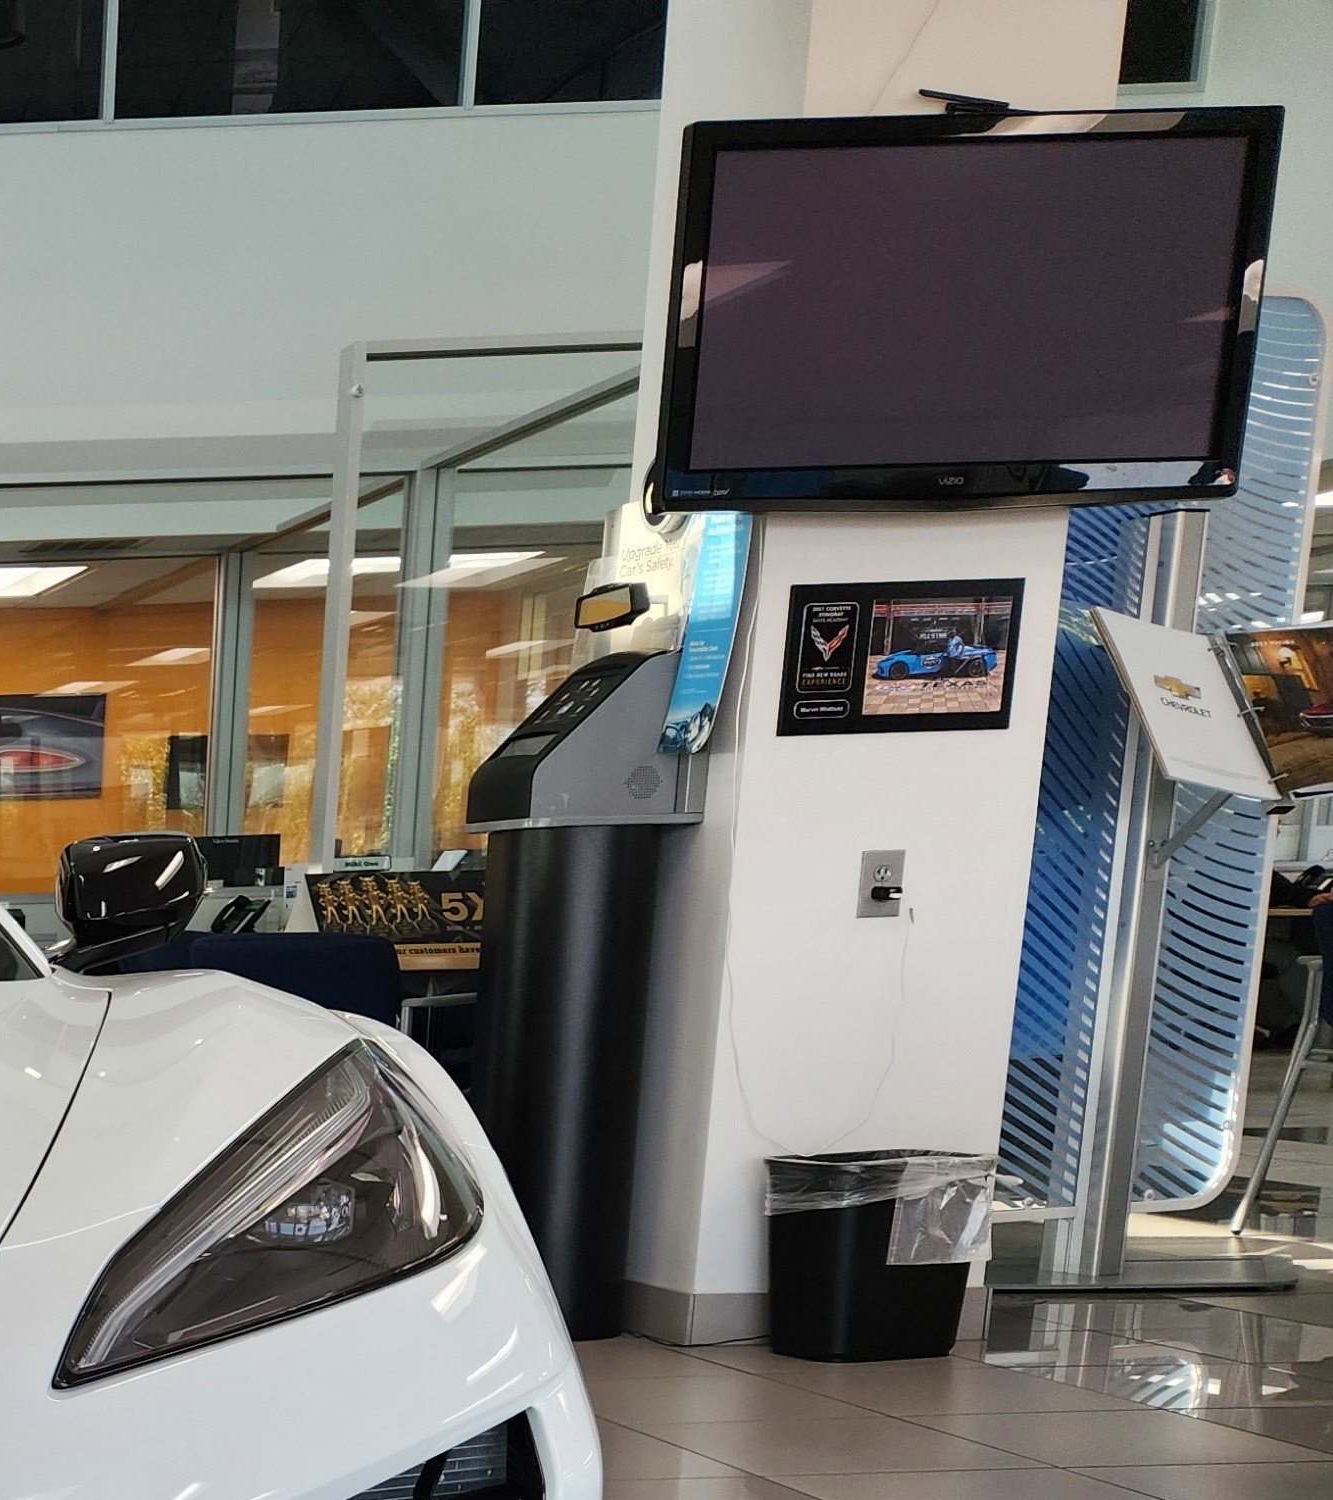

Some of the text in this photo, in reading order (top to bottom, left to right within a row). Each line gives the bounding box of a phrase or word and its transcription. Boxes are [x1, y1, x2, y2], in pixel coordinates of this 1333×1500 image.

[622, 541, 663, 563] Upgrade
[620, 561, 645, 578] Car's
[802, 678, 846, 686] EXPERIENCE
[1160, 697, 1212, 718] CHEVROLET
[408, 947, 457, 955] customers
